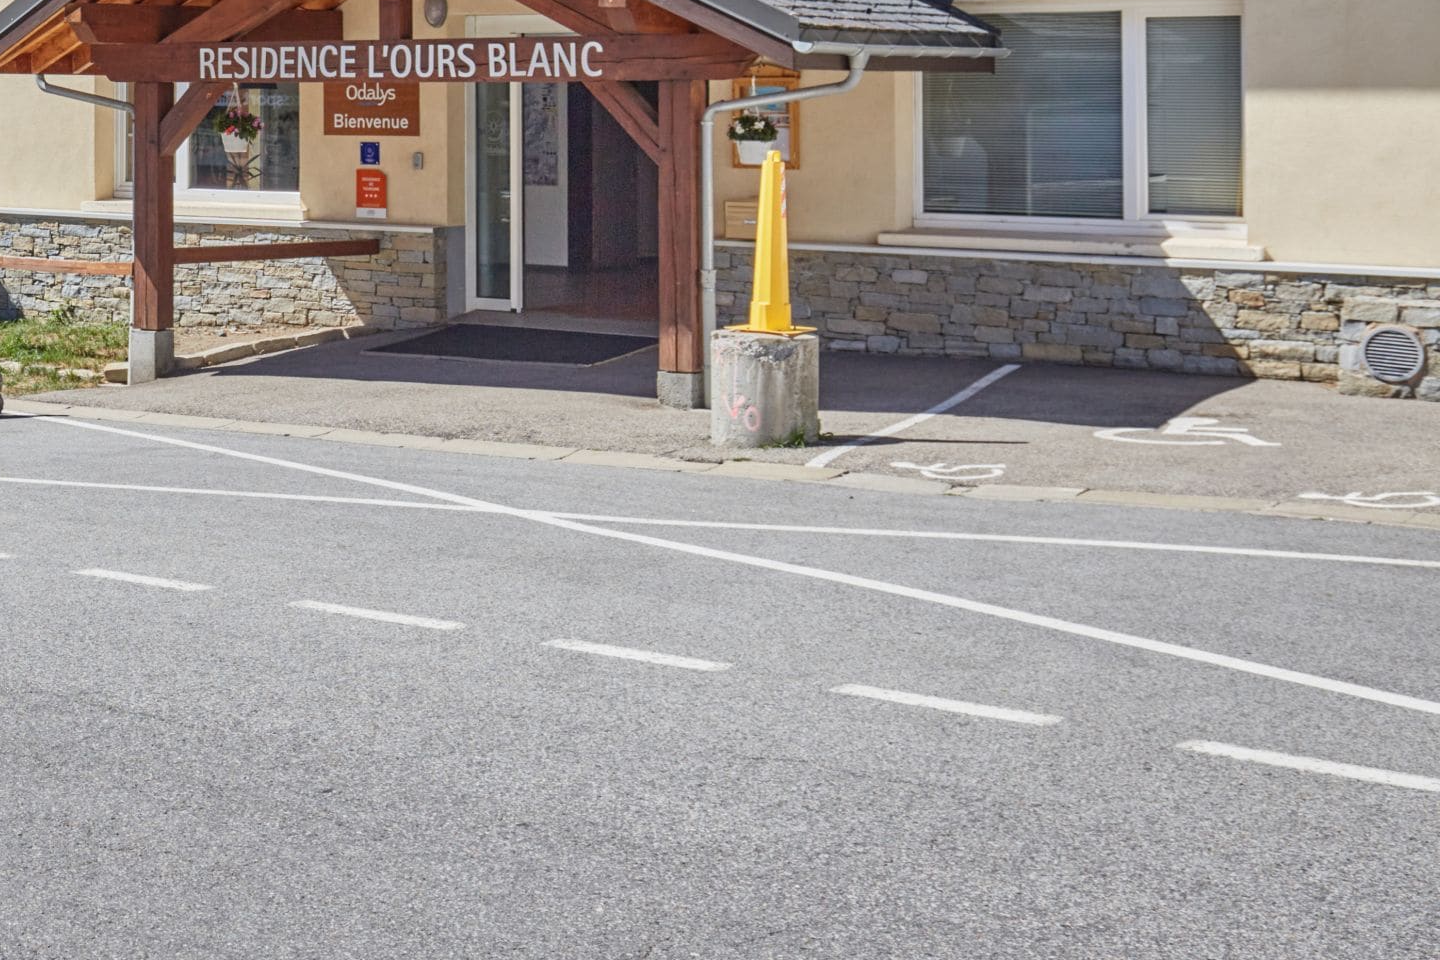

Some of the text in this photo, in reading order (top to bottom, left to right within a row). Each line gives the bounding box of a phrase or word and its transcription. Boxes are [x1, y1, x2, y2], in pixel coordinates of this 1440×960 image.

[199, 41, 604, 79] RESIDENCE L'OURS BLANC
[345, 82, 396, 106] Odalys
[333, 113, 409, 129] Bienvenue
